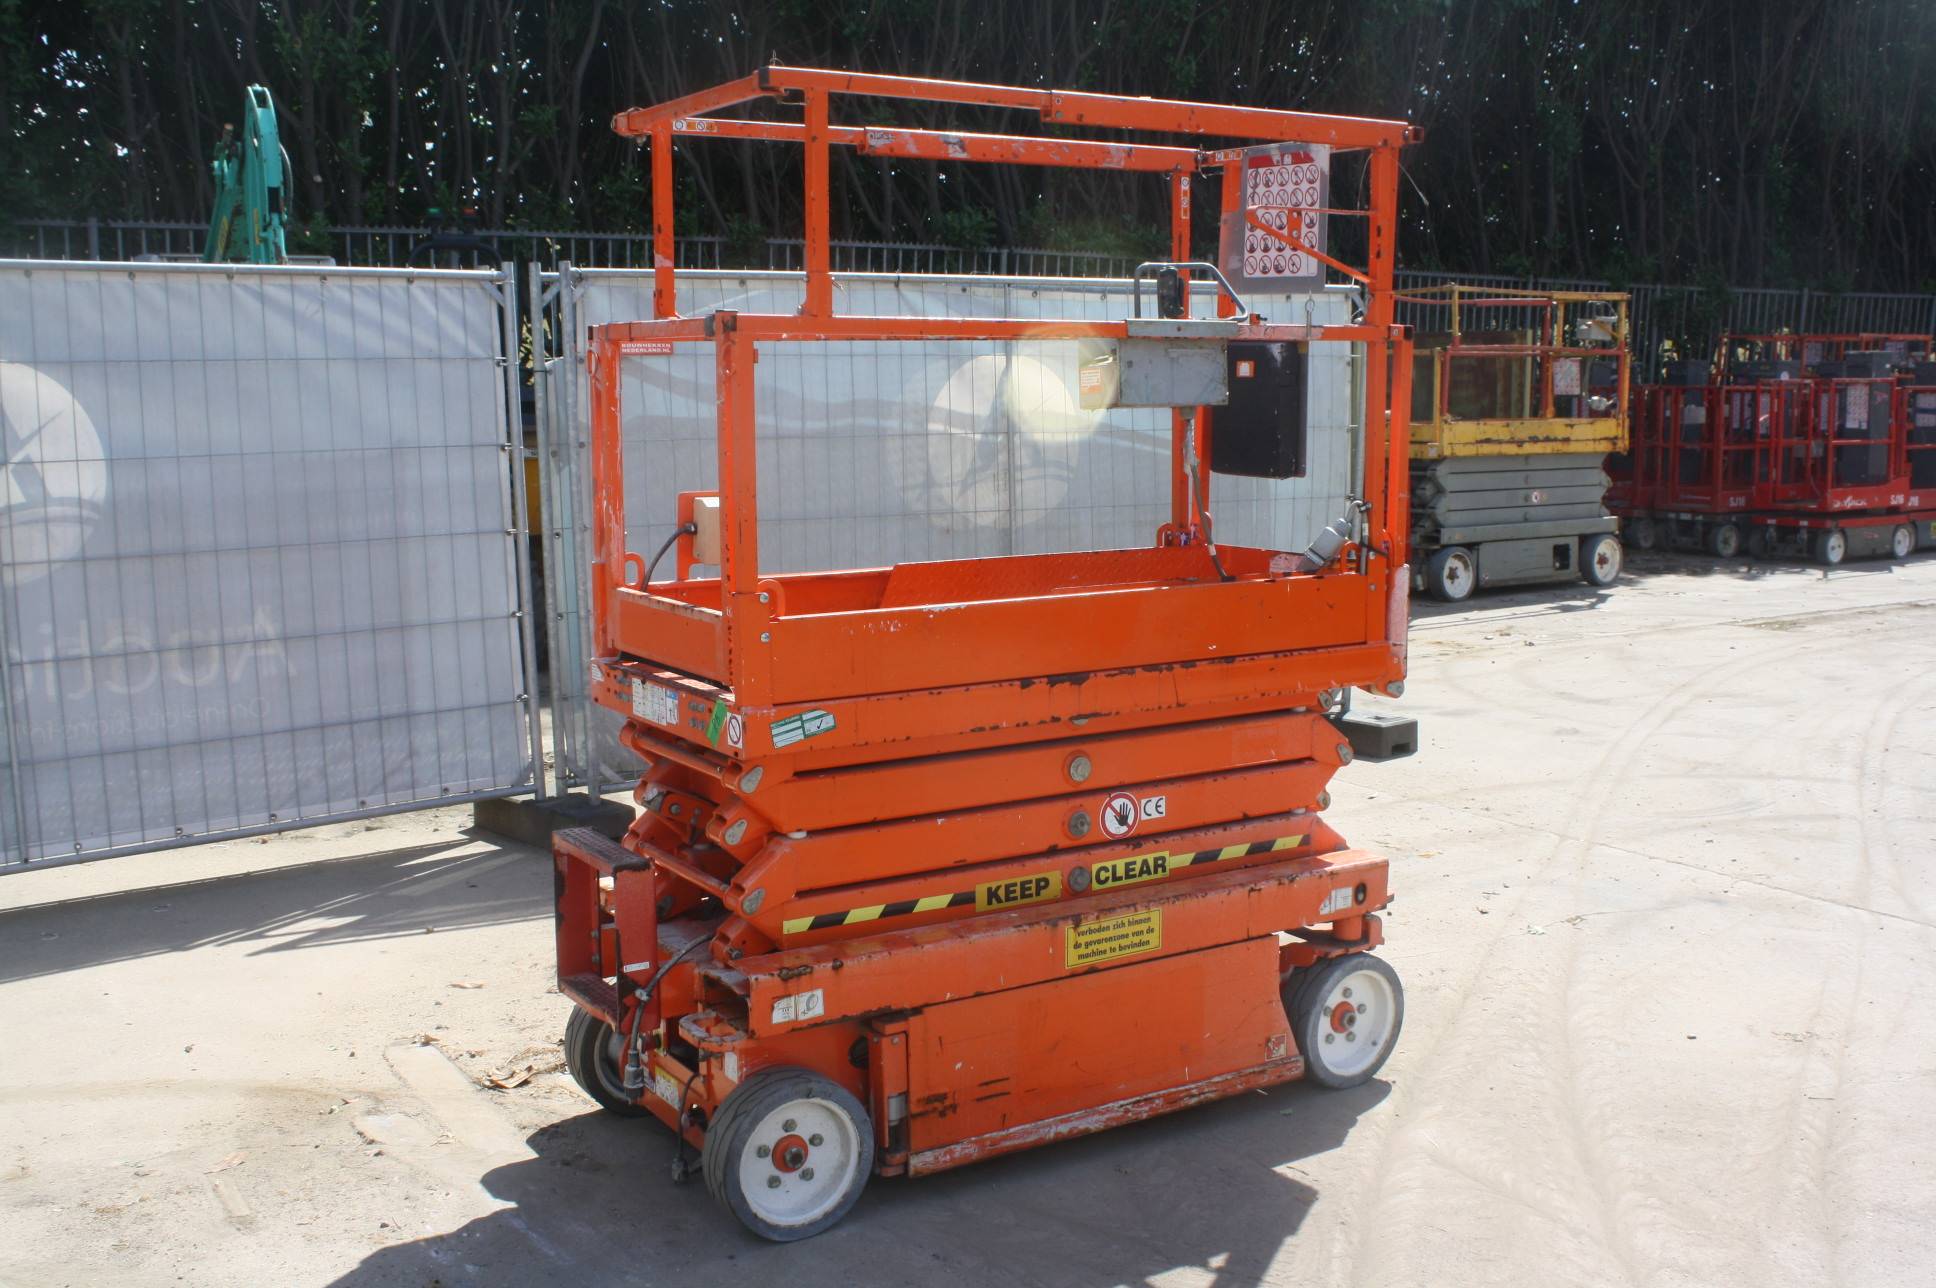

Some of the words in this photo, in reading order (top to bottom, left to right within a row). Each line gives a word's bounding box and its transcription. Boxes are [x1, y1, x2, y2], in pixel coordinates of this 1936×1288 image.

[1143, 797, 1165, 817] CE
[986, 876, 1050, 906] KEEP
[1094, 855, 1168, 886] CLEAR
[1112, 920, 1126, 930] zich
[1073, 940, 1083, 950] de
[1131, 929, 1144, 937] van
[1145, 926, 1155, 934] de
[1077, 948, 1107, 960] machine
[1109, 945, 1117, 953] te
[1118, 939, 1150, 951] bevinden
